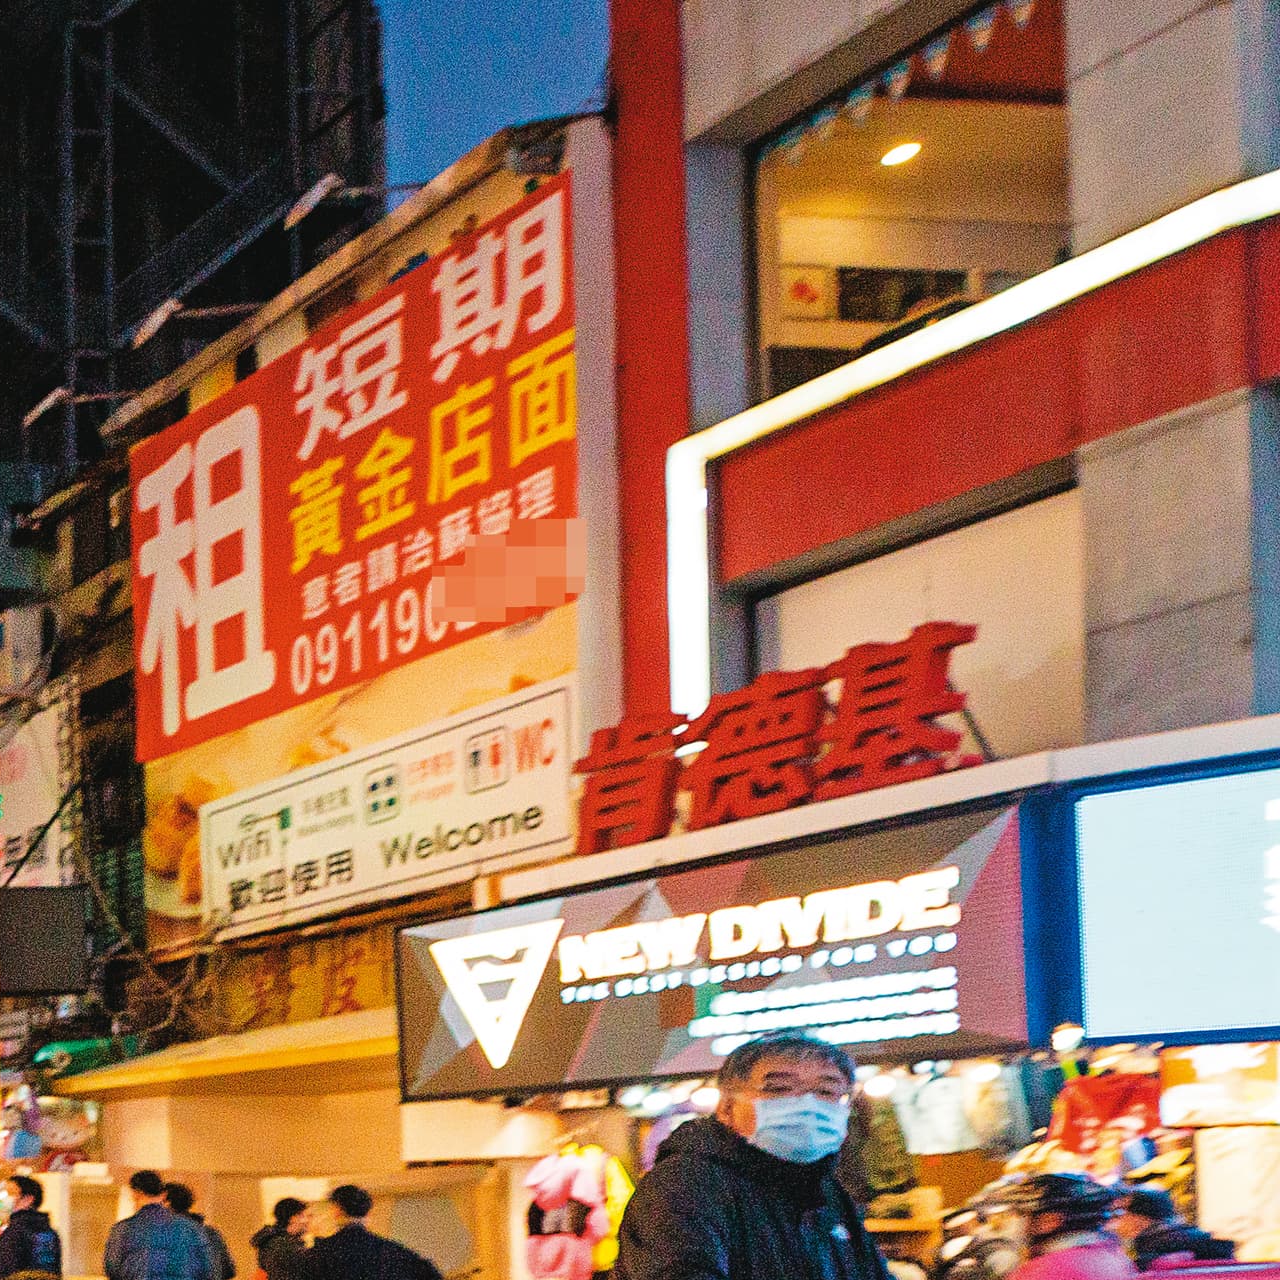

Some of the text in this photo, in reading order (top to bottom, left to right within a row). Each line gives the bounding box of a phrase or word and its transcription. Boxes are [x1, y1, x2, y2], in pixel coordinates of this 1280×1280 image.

[293, 189, 564, 460] 短期
[290, 329, 577, 574] 黃金店面
[140, 404, 276, 737] 租
[516, 718, 554, 772] WC
[378, 805, 542, 870] Welcome
[559, 866, 961, 984] NEW DIVIDE
